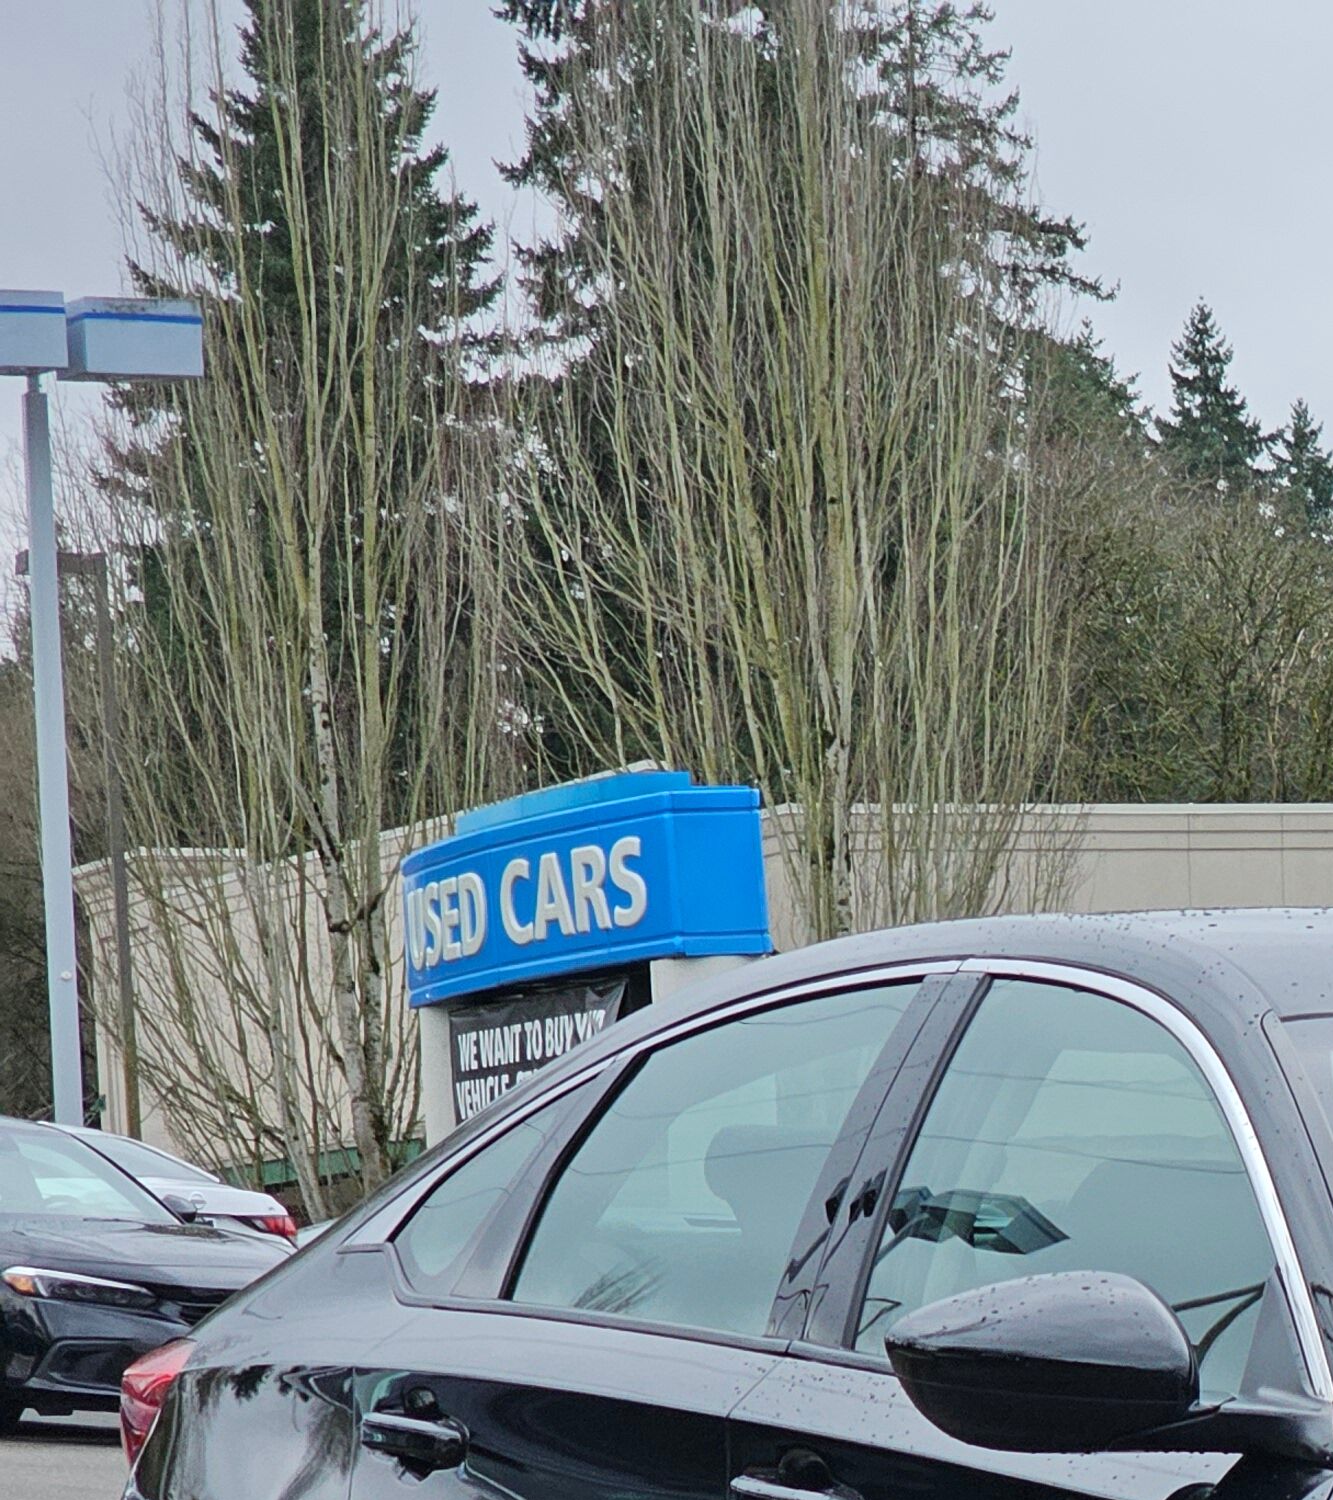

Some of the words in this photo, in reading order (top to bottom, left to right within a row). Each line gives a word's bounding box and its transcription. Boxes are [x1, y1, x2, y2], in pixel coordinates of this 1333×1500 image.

[407, 871, 487, 971] USED
[500, 835, 648, 945] CARS
[458, 1031, 478, 1073] WE
[479, 1023, 522, 1069] WANT
[524, 1019, 543, 1061] TO
[545, 1014, 574, 1058] BUY
